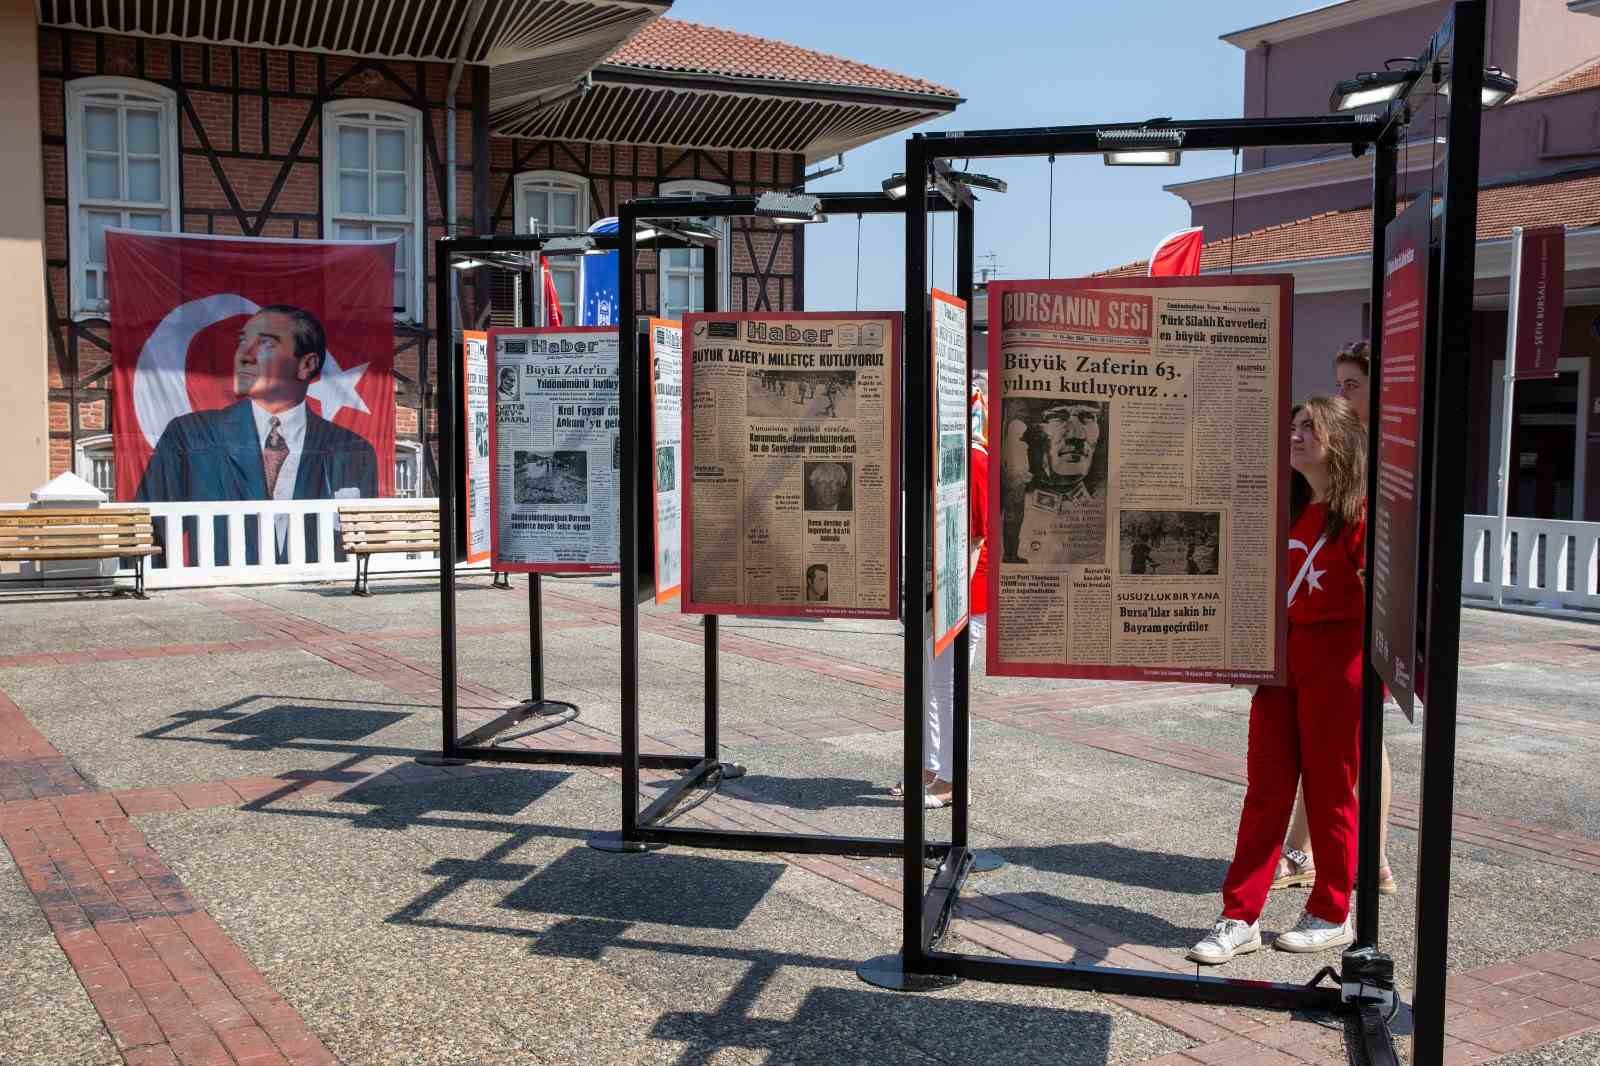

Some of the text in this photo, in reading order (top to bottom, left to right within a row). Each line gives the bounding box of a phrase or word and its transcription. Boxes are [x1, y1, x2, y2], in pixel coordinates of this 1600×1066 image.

[1004, 292, 1100, 328] BURSANIN
[1160, 314, 1267, 330] Türk Silahlı Kuvvetleri
[747, 319, 834, 343] Haber
[1160, 332, 1171, 341] en
[1175, 330, 1206, 344] büyük
[1210, 333, 1267, 345] güvencemiz
[531, 339, 599, 353] Haber
[819, 353, 885, 367] KUTLUYORUZ
[1004, 353, 1181, 380] Büyük Zaferin 63.
[564, 364, 607, 375] Zafer'in
[1003, 374, 1051, 394] yılını
[577, 405, 605, 417] Faysal
[556, 418, 601, 429] Ankara'ya
[1190, 592, 1220, 600] YANA
[1119, 605, 1217, 617] Bursa'lılar sakin bir
[1123, 620, 1209, 635] Bayram geçirdiler
